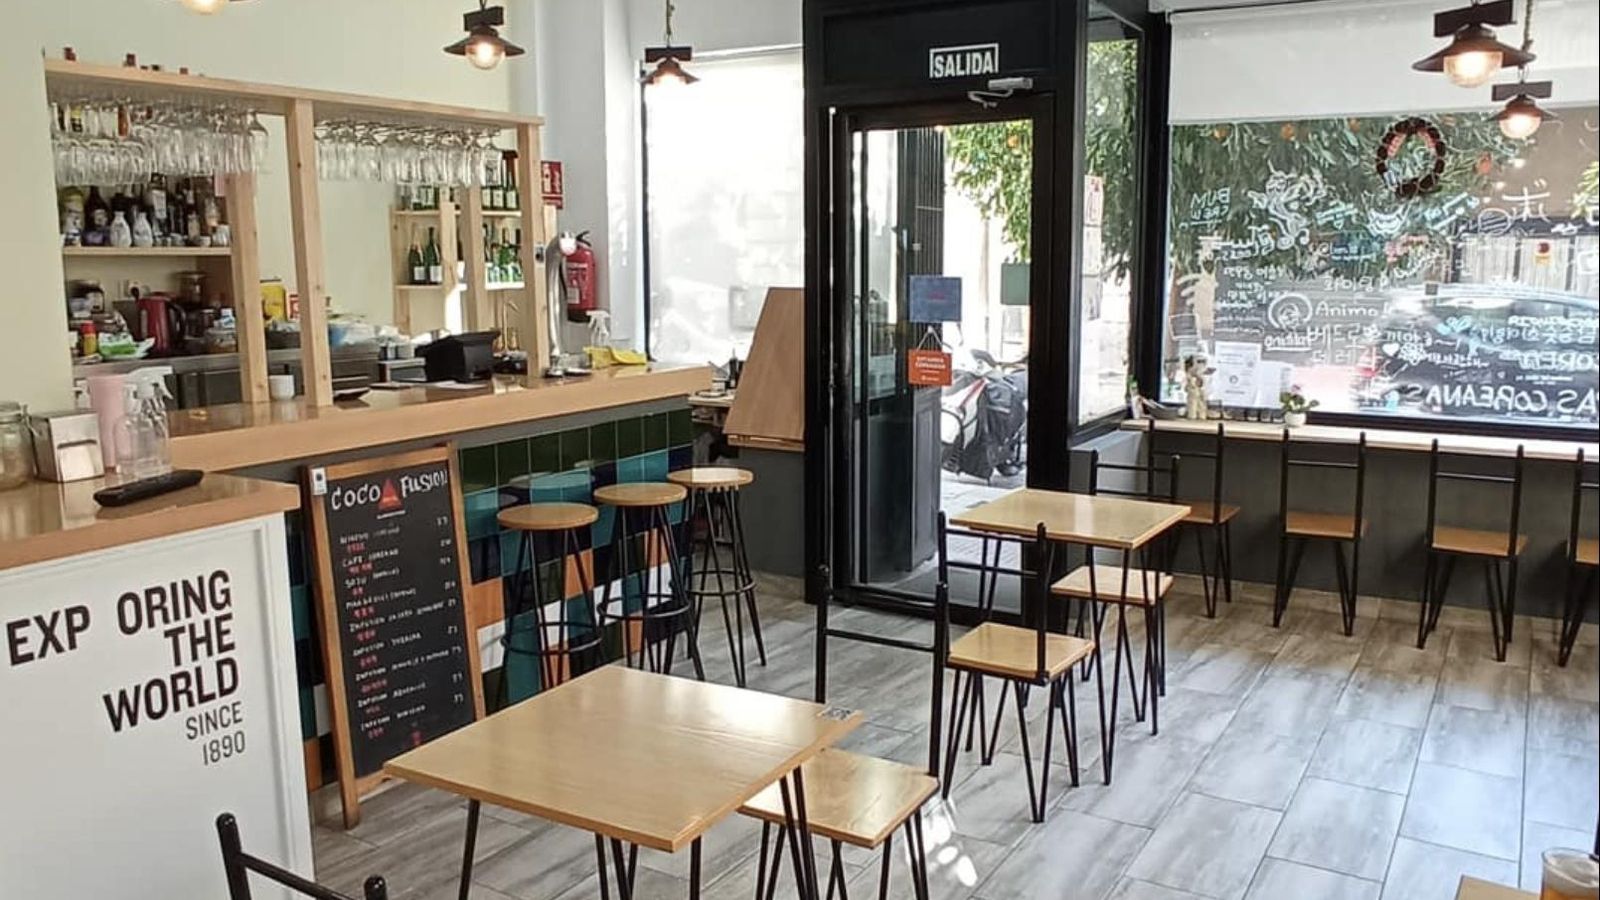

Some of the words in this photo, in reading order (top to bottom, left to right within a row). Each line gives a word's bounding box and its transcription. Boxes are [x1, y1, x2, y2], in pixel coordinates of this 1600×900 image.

[933, 51, 996, 79] SALIDA
[331, 483, 381, 510] COCO
[6, 604, 91, 667] EXP
[116, 569, 233, 636] ORING
[163, 612, 236, 667] THE
[102, 656, 239, 733] WORLD
[185, 701, 244, 741] SINCE
[202, 730, 246, 766] 1890
